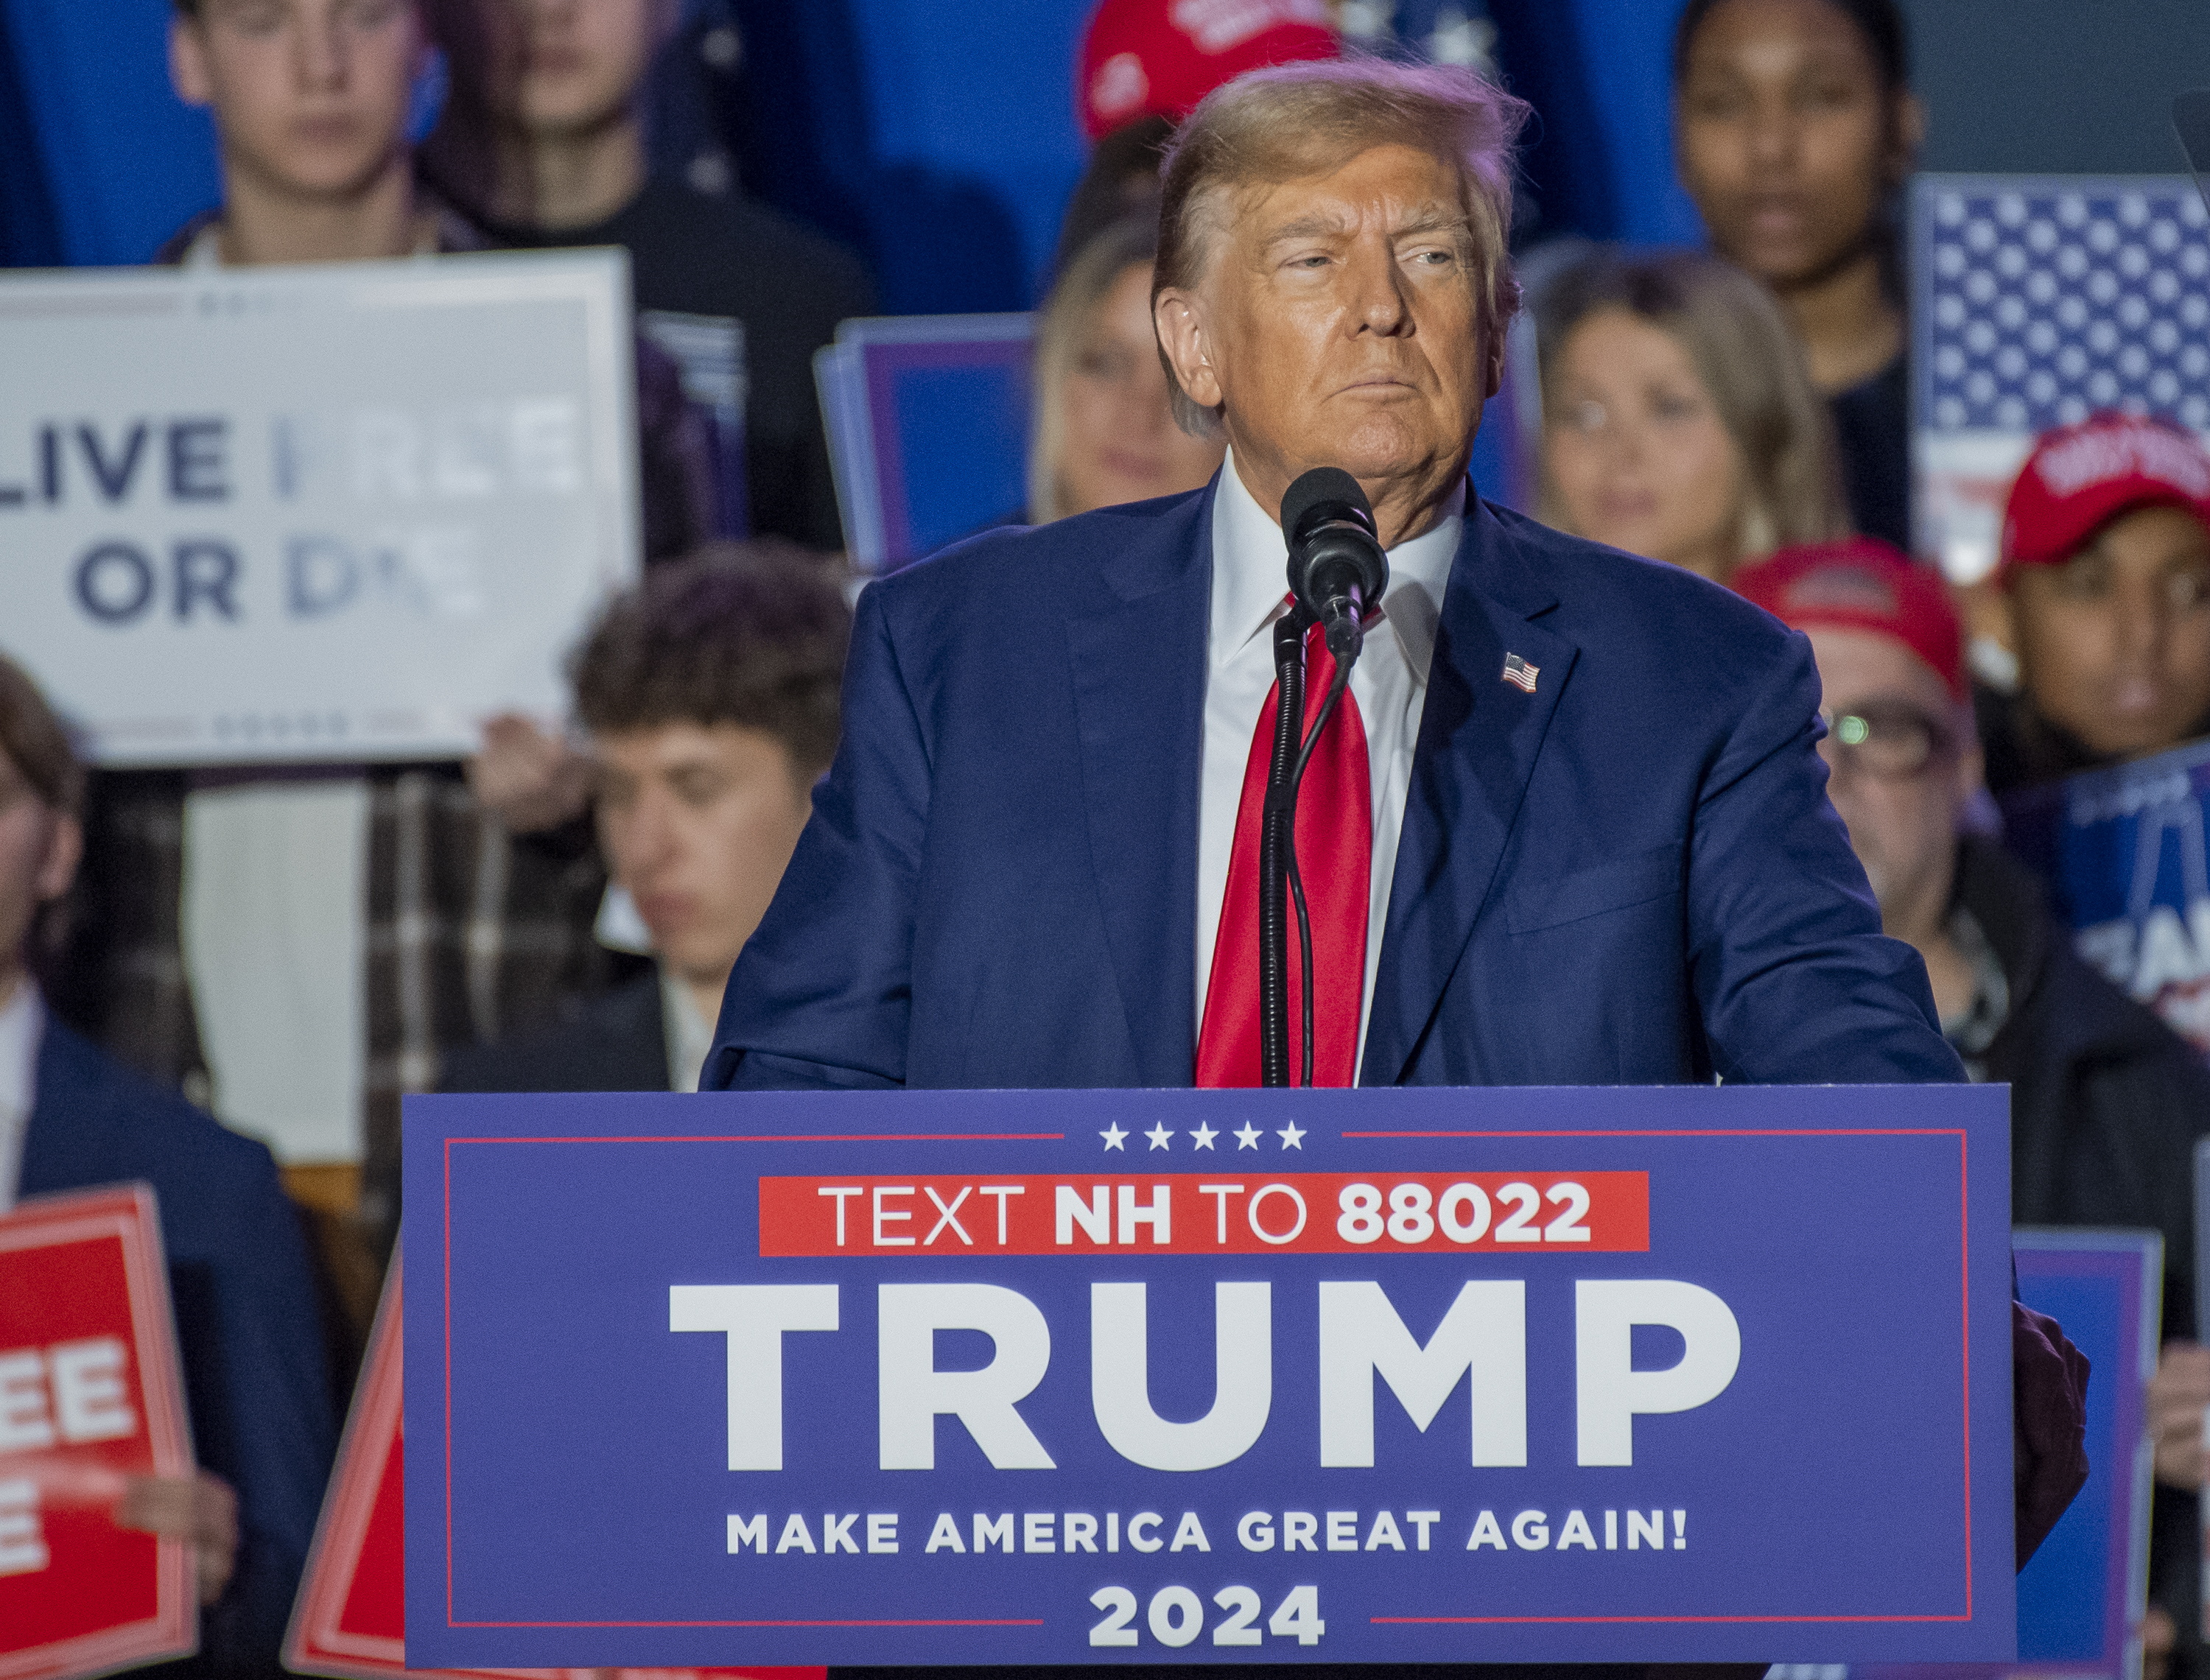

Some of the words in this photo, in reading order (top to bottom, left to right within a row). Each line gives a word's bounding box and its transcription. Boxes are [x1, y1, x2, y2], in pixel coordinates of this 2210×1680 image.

[71, 538, 243, 628] OR
[818, 1185, 1025, 1246] TEXT
[1055, 1184, 1171, 1245] NH
[1199, 1183, 1308, 1245] TO
[1336, 1181, 1591, 1244] 88022
[669, 1279, 1741, 1472] TRUMP
[726, 1513, 899, 1554] MAKE
[925, 1511, 1211, 1553] AMERICA
[1237, 1511, 1441, 1552] GREAT
[1466, 1509, 1686, 1550] AGAIN!
[1089, 1585, 1325, 1647] 2024
